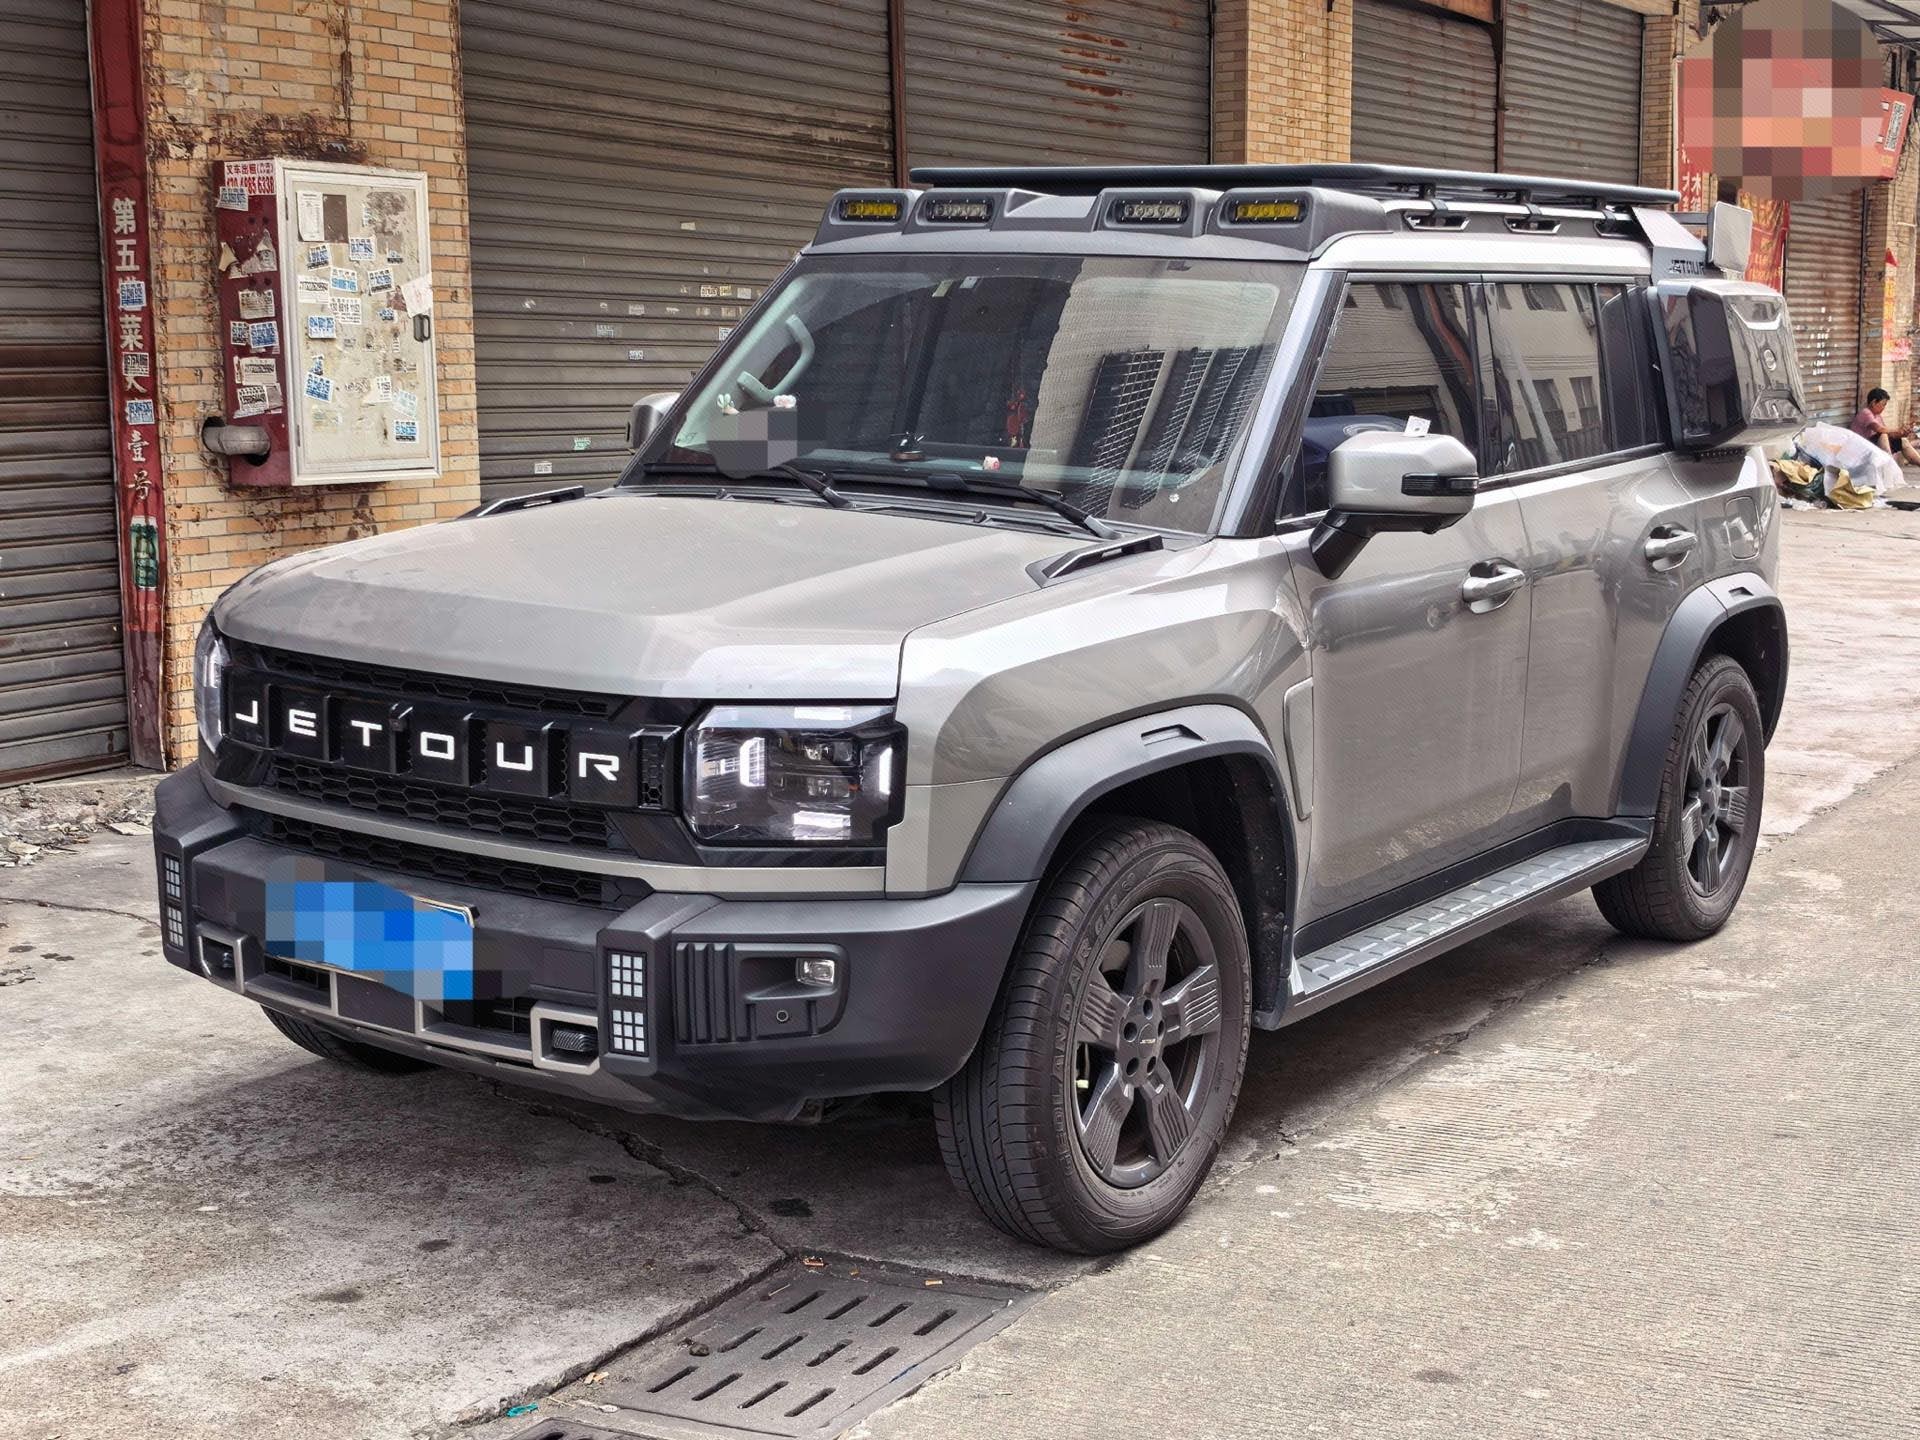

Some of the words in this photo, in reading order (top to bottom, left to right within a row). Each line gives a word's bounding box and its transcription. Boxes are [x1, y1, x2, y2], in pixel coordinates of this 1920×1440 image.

[112, 196, 152, 501] 第五菜壹号
[235, 700, 620, 781] JETOUR
